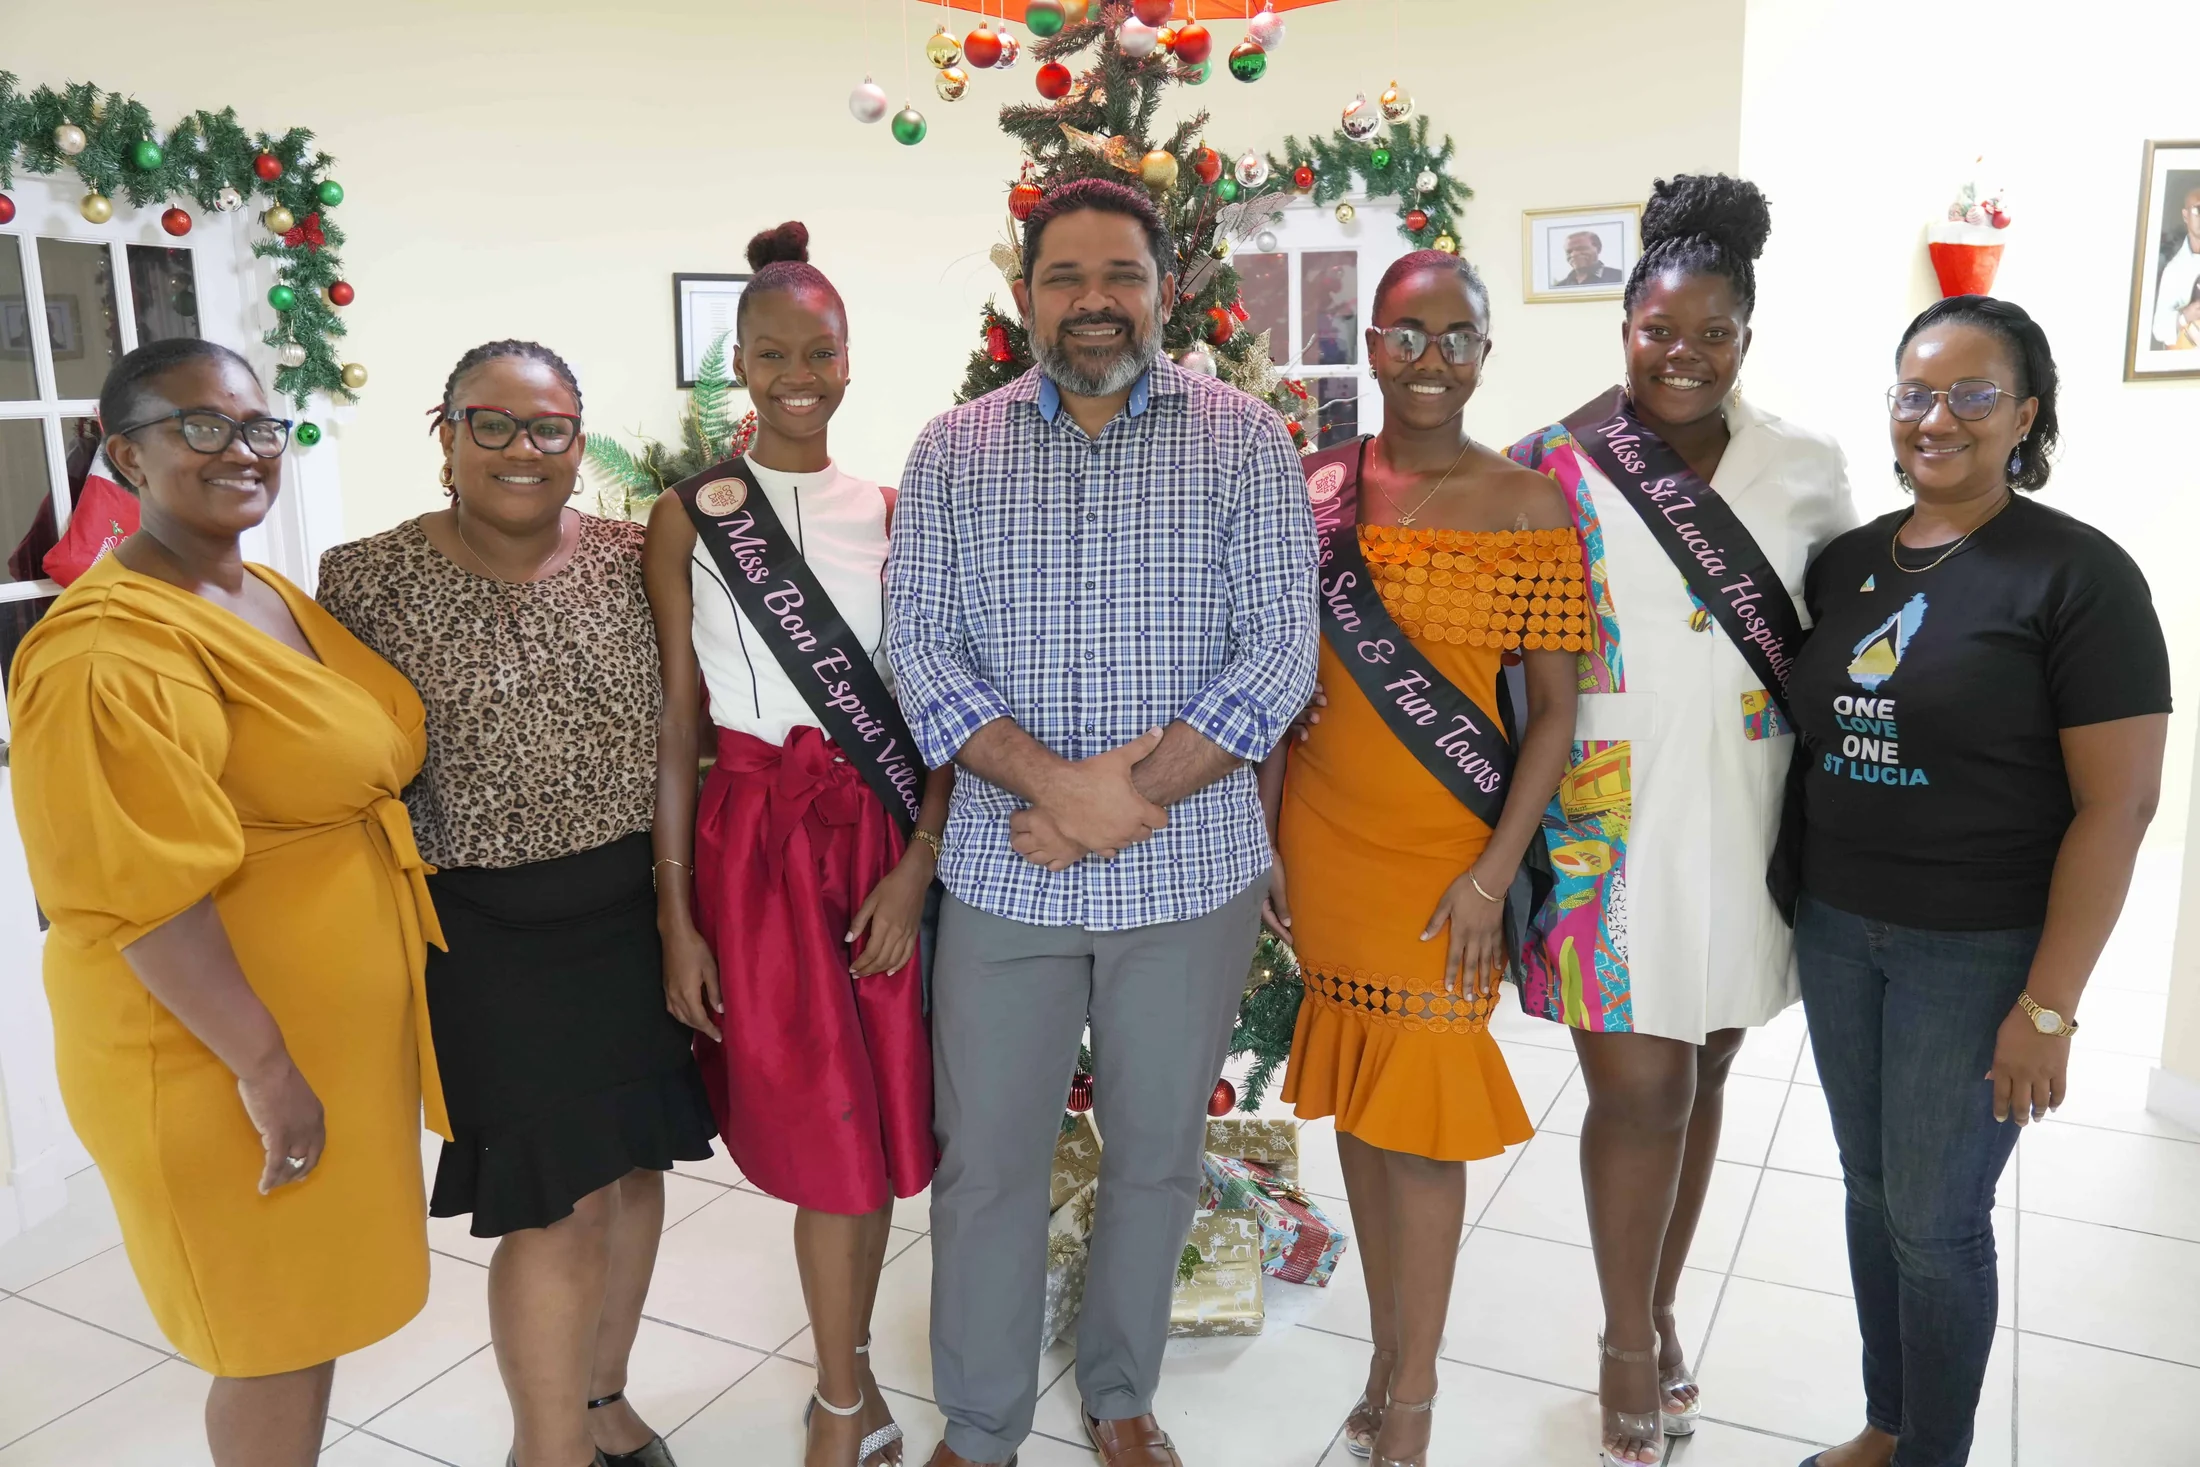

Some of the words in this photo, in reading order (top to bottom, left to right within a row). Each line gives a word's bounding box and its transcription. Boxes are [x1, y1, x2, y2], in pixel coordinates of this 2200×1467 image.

[1597, 416, 1646, 474] Miss
[707, 492, 722, 507] Day
[717, 510, 769, 584] Miss
[763, 579, 816, 652] Bon
[812, 647, 886, 743] Esprit
[876, 737, 920, 822] Villas
[1321, 570, 1359, 633] Sun
[1357, 639, 1395, 665] &
[1384, 669, 1437, 726] Fun
[1434, 714, 1501, 793] Tours
[1833, 695, 1896, 720] ONE
[1835, 714, 1899, 739] LOVE
[1842, 734, 1899, 765] ONE
[1823, 752, 1844, 776] ST
[1850, 761, 1930, 786] LUCIA
